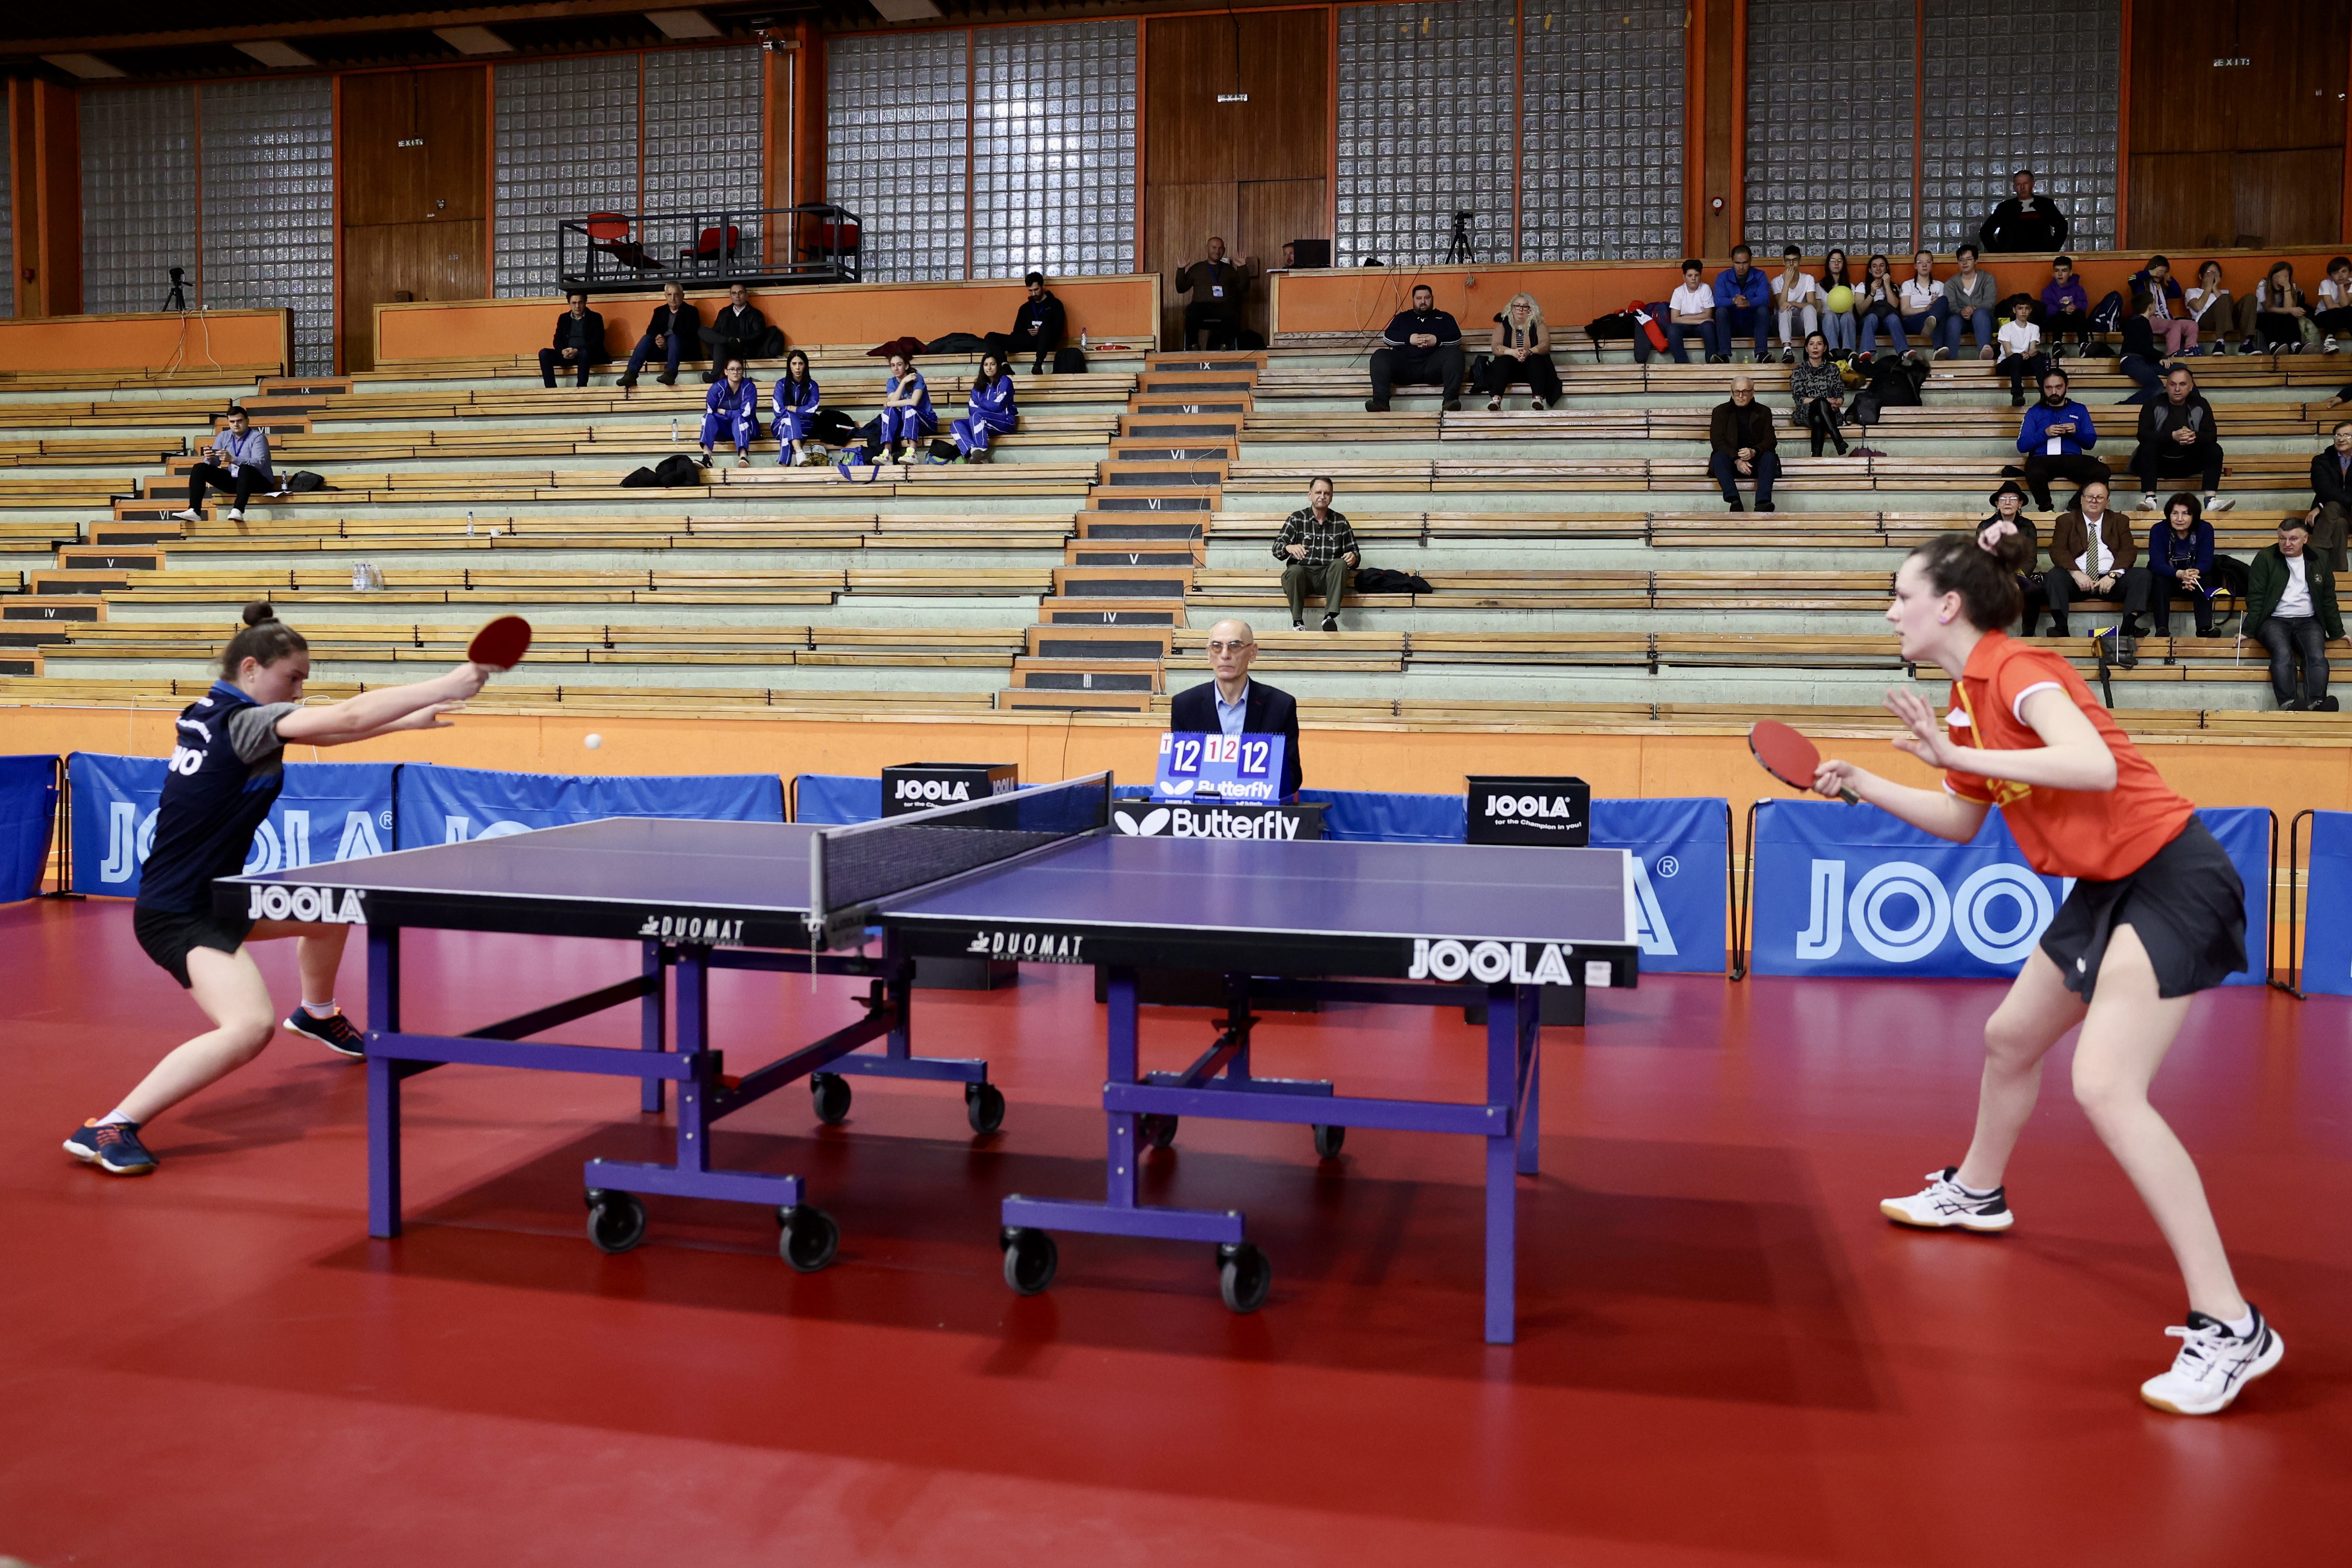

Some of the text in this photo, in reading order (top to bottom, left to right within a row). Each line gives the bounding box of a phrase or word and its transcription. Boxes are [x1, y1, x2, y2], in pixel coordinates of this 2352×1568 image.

[1183, 405, 1198, 414] VIII
[1171, 449, 1185, 459] VII
[1148, 499, 1161, 510] VI
[159, 511, 169, 520] VI
[107, 558, 114, 568] V
[1129, 554, 1139, 565] V
[45, 608, 55, 617] IV
[1103, 612, 1117, 623] IV
[1083, 673, 1092, 688] III
[1164, 739, 1170, 751] T
[1174, 740, 1201, 772] 12
[1242, 741, 1269, 773] 12
[895, 780, 969, 801] JOOLA
[1198, 780, 1273, 799] Butterfly
[1485, 795, 1570, 818] JOOLA
[1173, 808, 1300, 841] Butterfly
[1520, 819, 1556, 830] Champion
[1566, 821, 1582, 830] you!
[248, 885, 367, 924] JOOLA
[1796, 859, 2077, 964] JOO
[661, 916, 744, 940] DUOMAT
[992, 932, 1084, 957] DUOMAT
[1408, 939, 1572, 986] JOOLA
